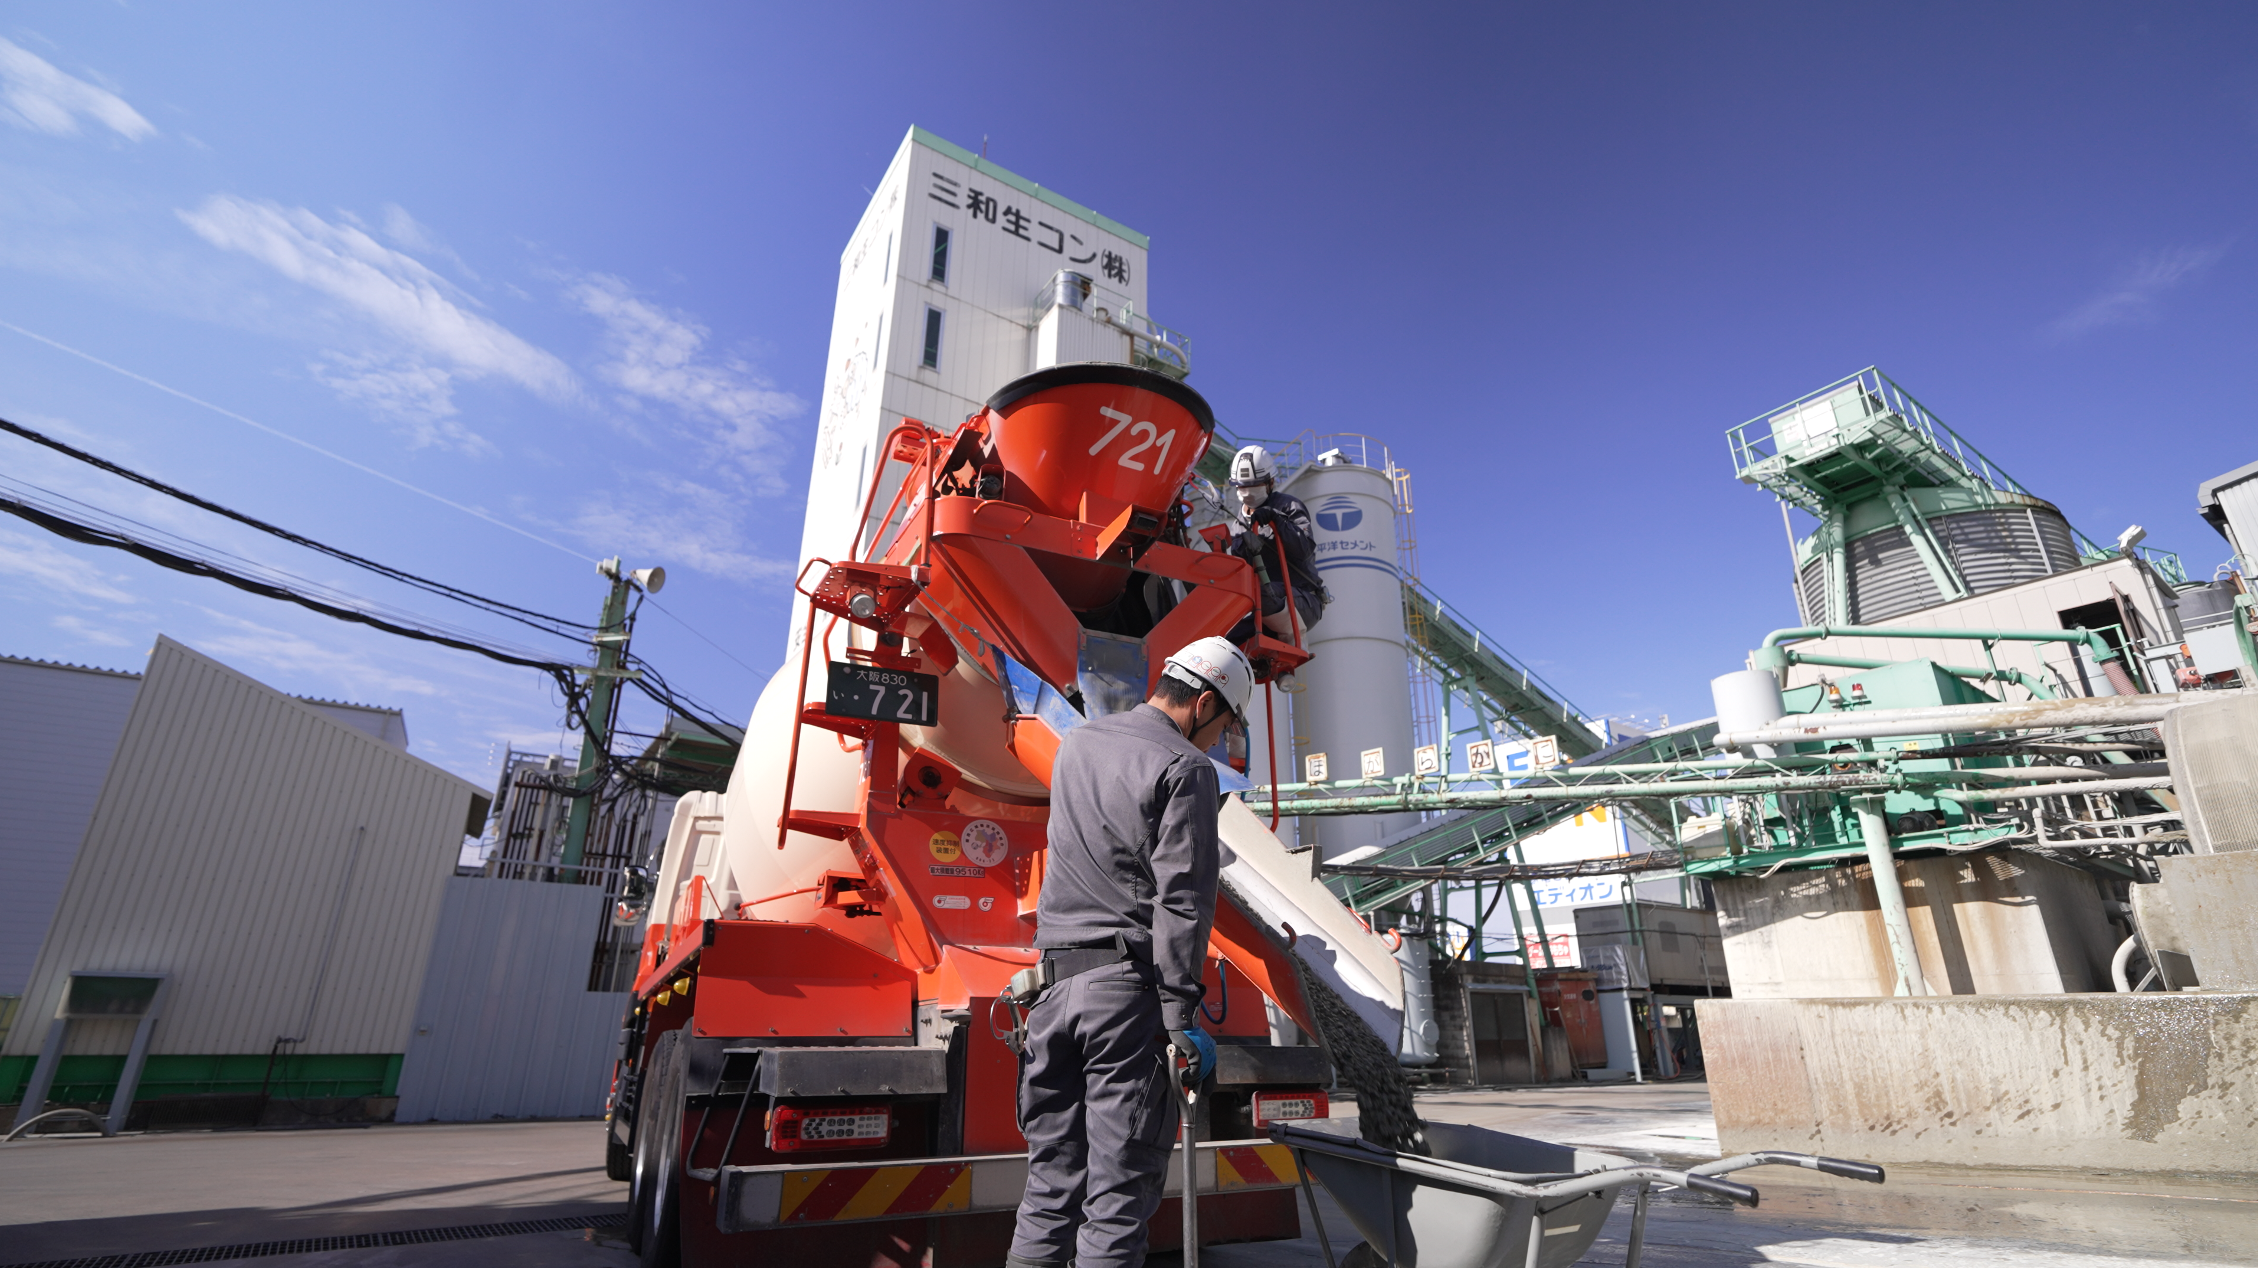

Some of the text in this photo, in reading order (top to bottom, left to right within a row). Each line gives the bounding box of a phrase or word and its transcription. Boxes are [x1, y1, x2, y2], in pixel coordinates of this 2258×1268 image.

[1089, 406, 1176, 475] 721
[857, 670, 907, 686] 大阪830
[833, 690, 844, 700] い
[1533, 882, 1613, 905] エディオン
